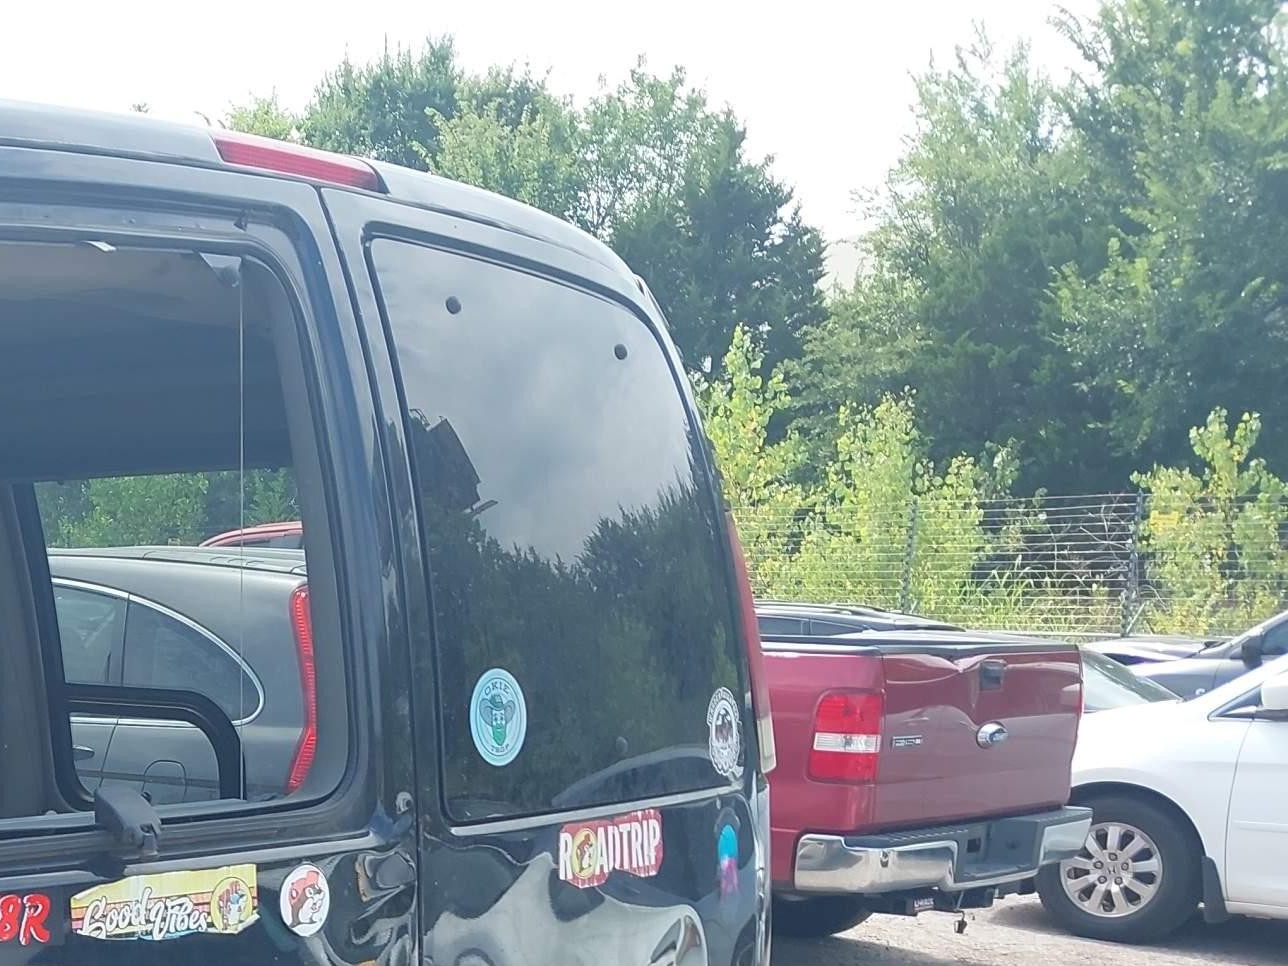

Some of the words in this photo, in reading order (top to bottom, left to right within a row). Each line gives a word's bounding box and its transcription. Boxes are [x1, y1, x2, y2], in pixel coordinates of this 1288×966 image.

[484, 682, 510, 696] OKIE
[83, 886, 152, 940] Good
[150, 895, 208, 940] Vibes
